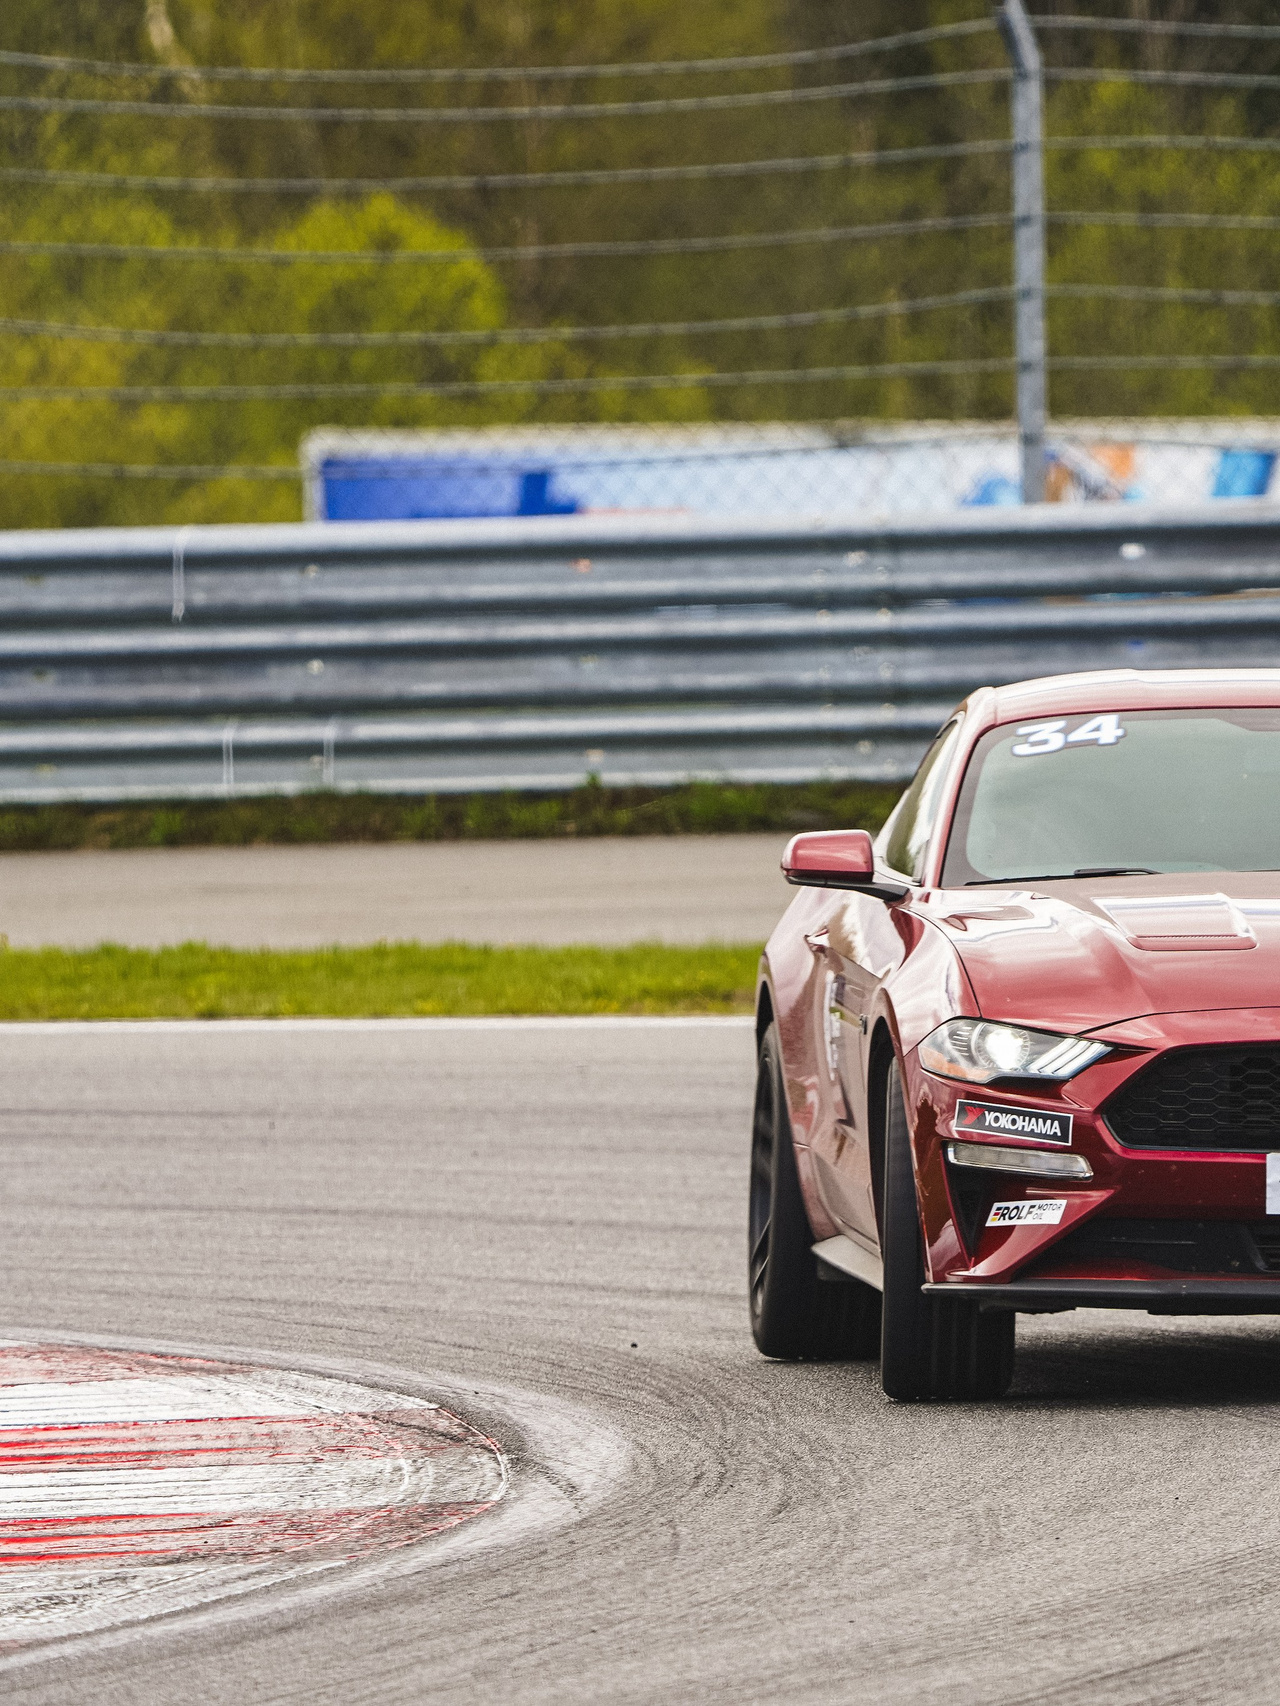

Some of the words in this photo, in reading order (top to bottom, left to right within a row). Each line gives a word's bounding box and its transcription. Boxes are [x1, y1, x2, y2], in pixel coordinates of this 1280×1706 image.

[1012, 714, 1126, 757] 34
[984, 1111, 1061, 1136] YOKOHAMA
[998, 1204, 1037, 1221] ROLF
[1037, 1203, 1062, 1211] MOTOR
